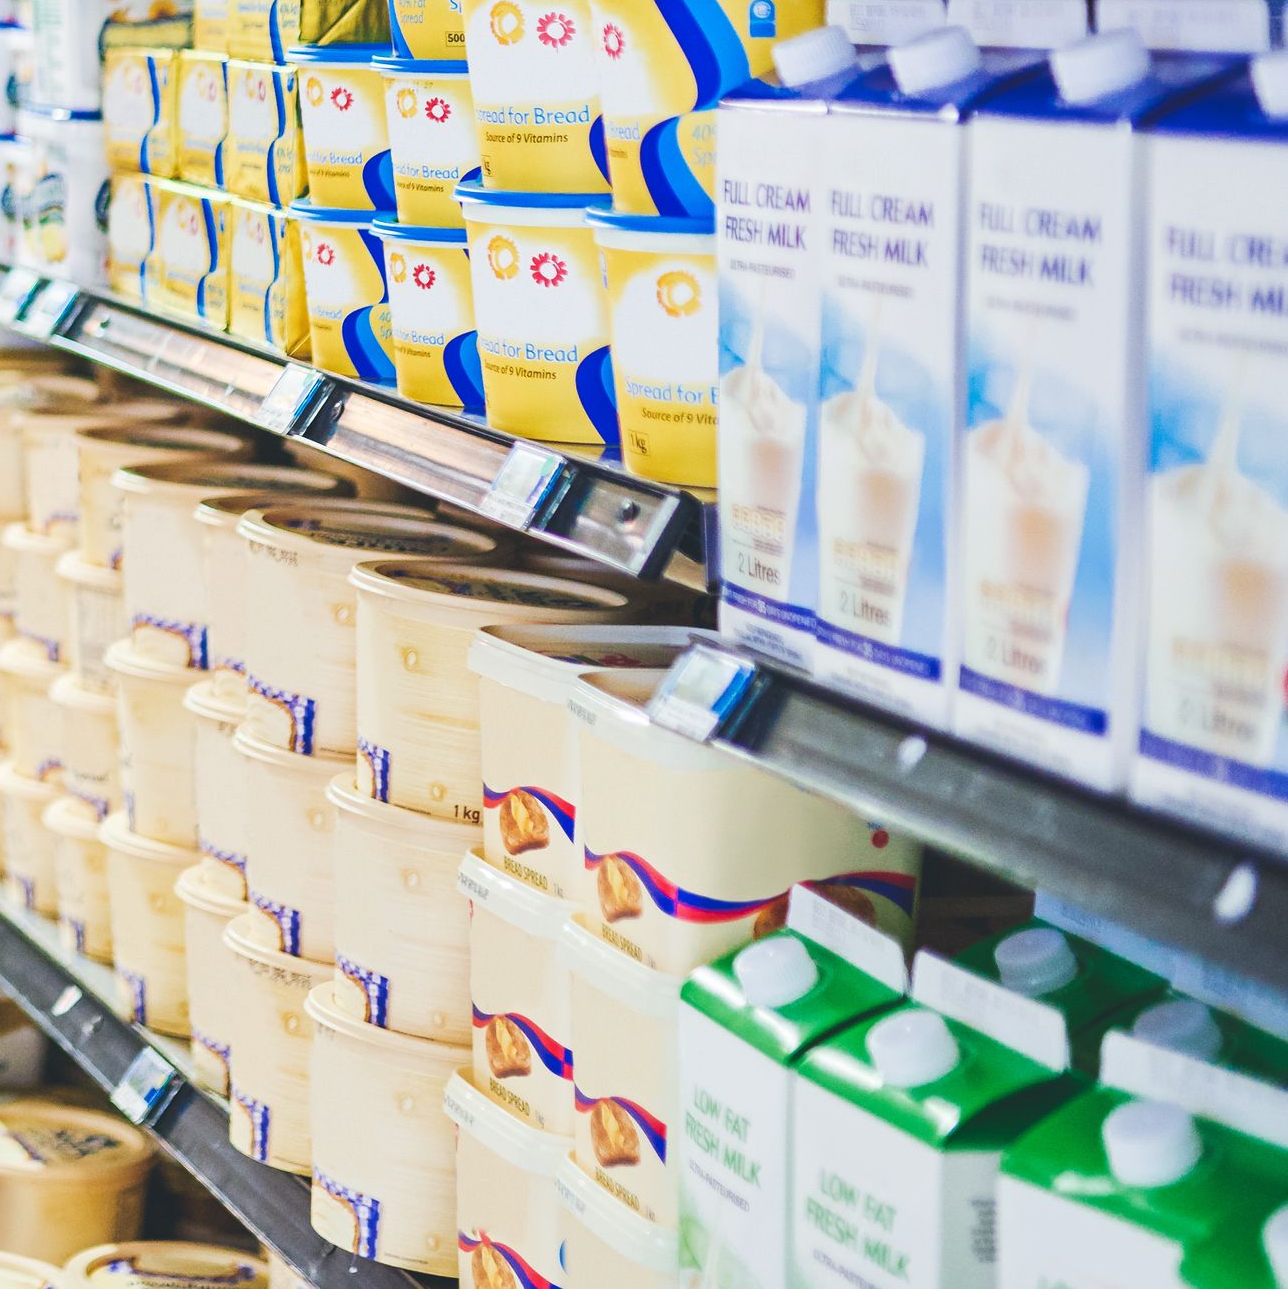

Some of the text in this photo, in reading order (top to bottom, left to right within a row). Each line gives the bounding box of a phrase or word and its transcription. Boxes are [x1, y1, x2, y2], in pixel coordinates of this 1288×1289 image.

[447, 33, 465, 43] 500
[509, 108, 529, 125] for
[533, 104, 590, 124] Bread
[507, 132, 515, 144] of
[516, 133, 522, 143] 9
[524, 133, 569, 144] Vitamins
[416, 181, 444, 192] Vitamins
[422, 165, 459, 180] Bread
[724, 179, 811, 214] FULL CREAM
[830, 189, 935, 228] FULL CREAM
[725, 215, 807, 251] FRESH MILK
[979, 201, 1103, 243] FULL CREAM
[832, 228, 930, 270] FRESH MILK
[980, 244, 1094, 288] FRESH MILK
[1228, 232, 1288, 269] CRE
[411, 332, 445, 345] Bread
[502, 342, 521, 359] for
[525, 343, 578, 362] Bread
[509, 366, 514, 376] 9
[515, 367, 557, 380] Vitamins
[625, 378, 672, 401] Spread
[677, 384, 703, 403] for
[642, 407, 719, 425] Source of 9 Vita
[636, 434, 647, 453] kg
[738, 552, 781, 586] 2 Litres
[840, 590, 892, 627] 2 Litres
[454, 805, 481, 824] 1 kg
[504, 855, 522, 878] BREAD
[523, 866, 548, 890] SPREAD
[602, 922, 619, 947] BREAD
[620, 935, 642, 962] SPREAD
[489, 1077, 506, 1101] BREAD
[507, 1090, 530, 1116] SPREAD
[694, 1085, 751, 1143] LOW FAT
[685, 1108, 762, 1189] FRESH MILK
[595, 1167, 614, 1193] BREAD
[615, 1182, 640, 1211] SPREAD
[819, 1168, 897, 1233] LOW FAT
[805, 1196, 911, 1282] FRESH MILK
